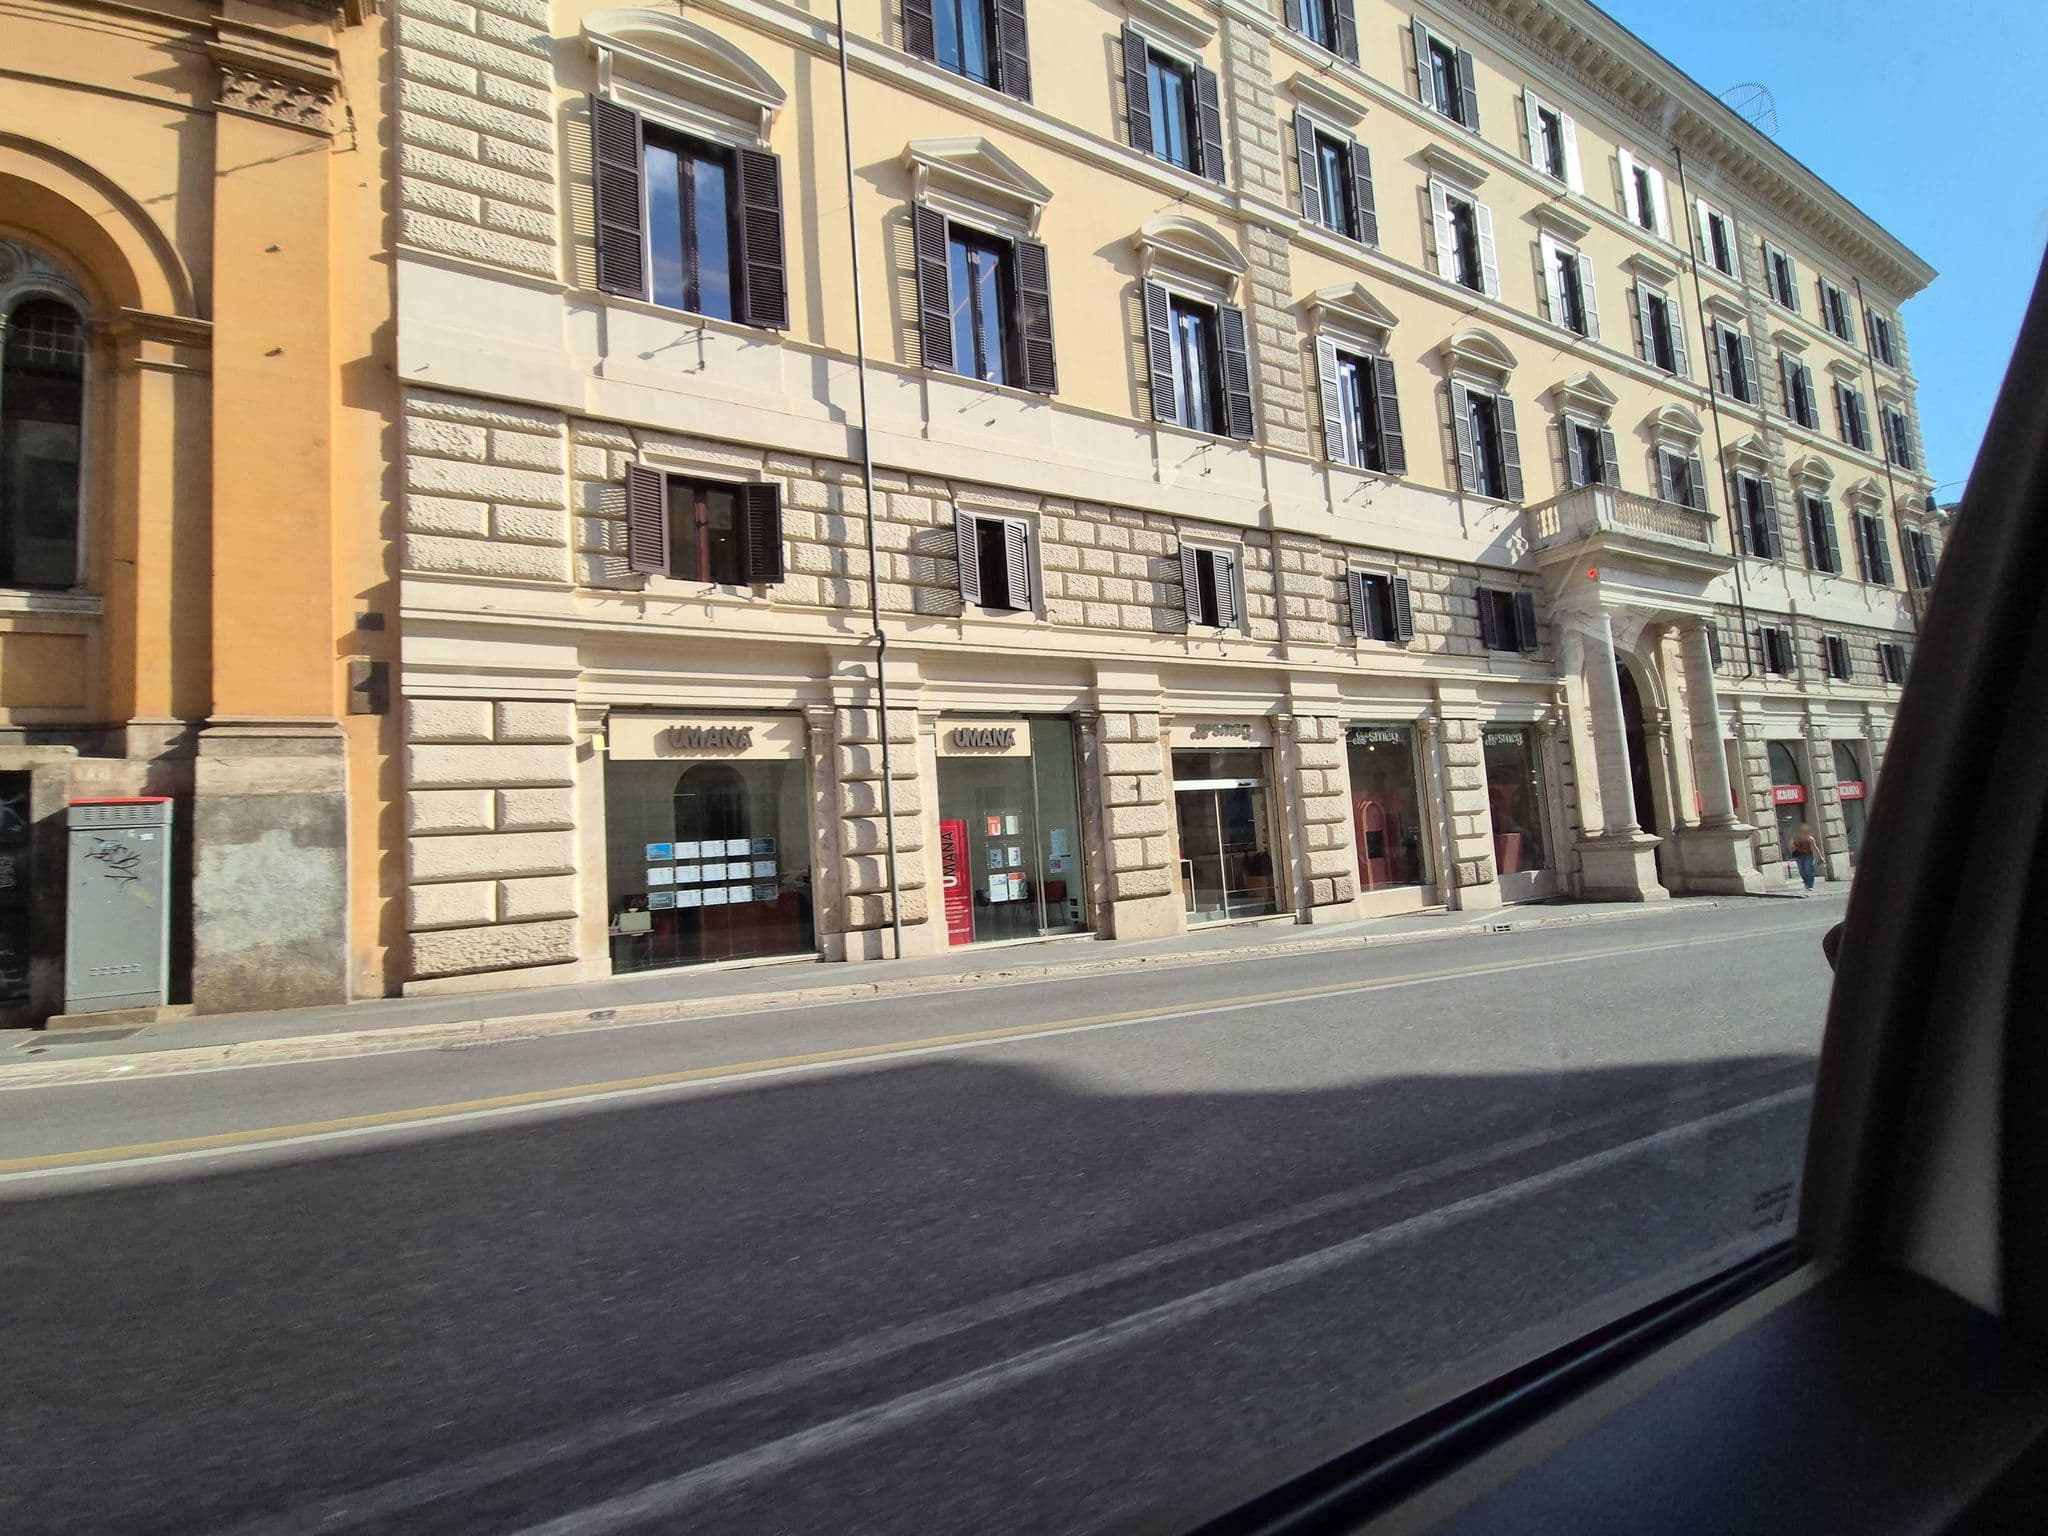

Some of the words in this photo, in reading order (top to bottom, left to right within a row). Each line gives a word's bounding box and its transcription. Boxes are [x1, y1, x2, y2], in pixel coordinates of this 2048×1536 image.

[669, 725, 754, 749] UMANA
[953, 727, 1016, 748] UMANA
[1369, 730, 1399, 745] smeg
[1498, 732, 1523, 745] smeg
[941, 831, 959, 888] UMANA
